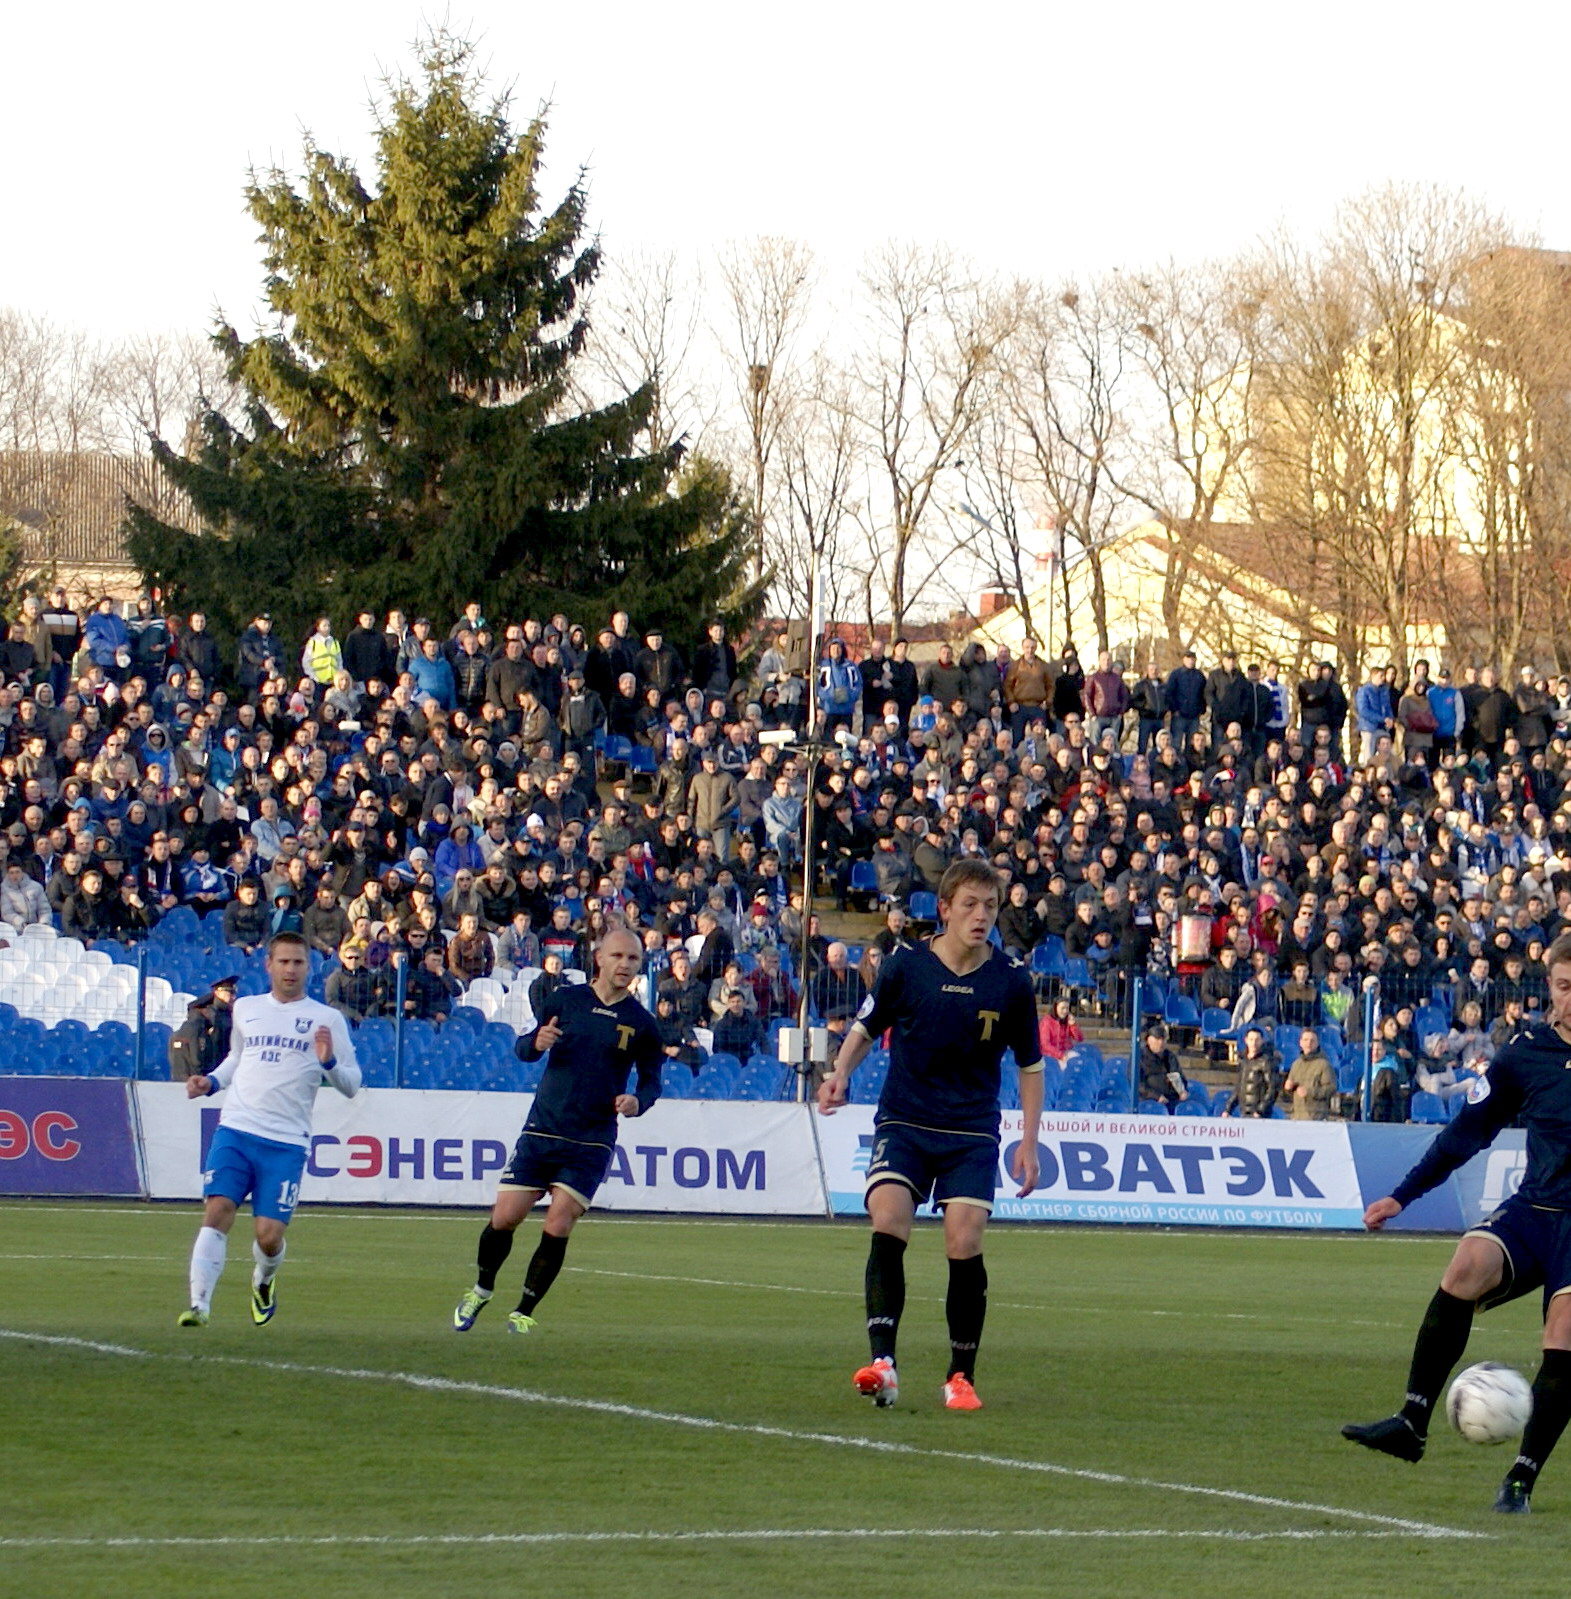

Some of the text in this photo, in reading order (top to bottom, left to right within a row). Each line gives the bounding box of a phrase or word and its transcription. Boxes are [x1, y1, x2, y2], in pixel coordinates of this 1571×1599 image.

[1095, 1122, 1104, 1133] И
[1110, 1122, 1177, 1136] ВЕЛИКОЙ
[1182, 1125, 1245, 1138] СТРАНЫ!
[858, 1134, 1325, 1198] ОВАТЭК
[1001, 1203, 1323, 1224] ПАРТНЕР СБОРНОЙ РОССИИ ПО ФУТБОЛУ
